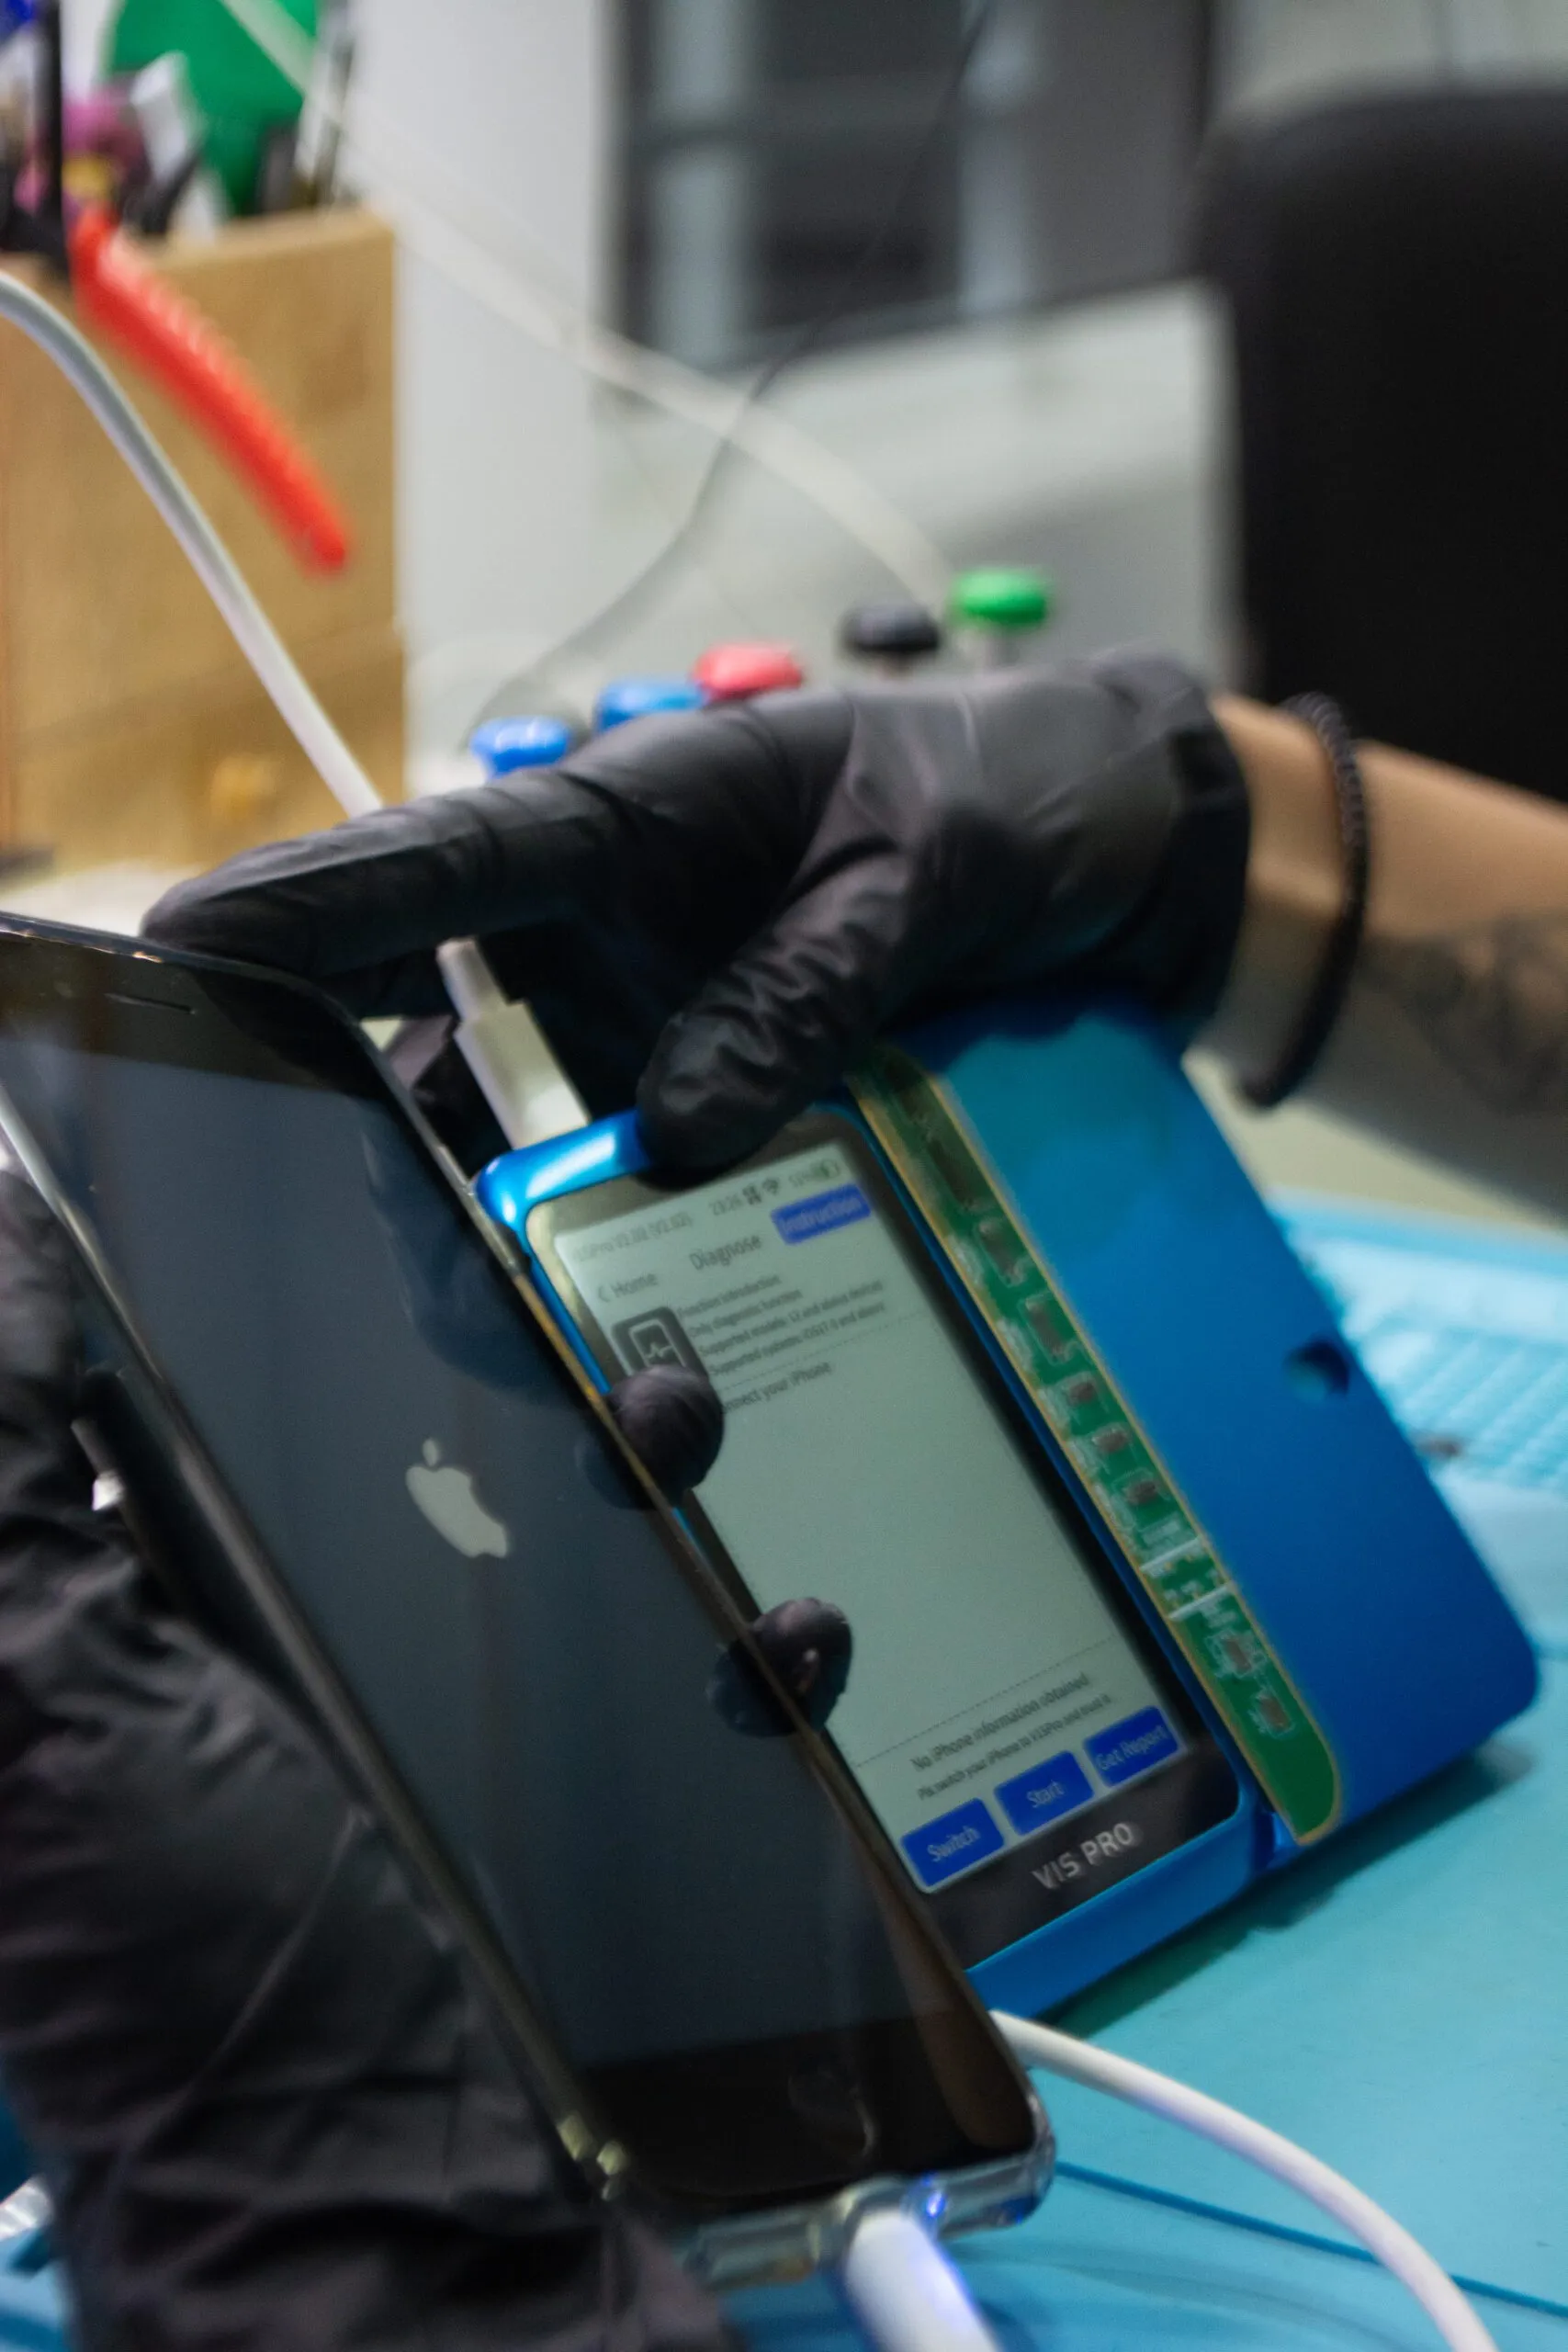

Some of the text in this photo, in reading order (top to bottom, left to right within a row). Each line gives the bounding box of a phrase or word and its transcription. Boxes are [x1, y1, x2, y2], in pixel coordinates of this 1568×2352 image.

[690, 1235, 761, 1272] Diagnose
[610, 1272, 660, 1298] Home
[761, 1379, 788, 1402] your
[789, 1362, 832, 1385] iPhone
[909, 1671, 1090, 1773] No iPhone information obtained
[964, 1758, 987, 1780] your
[987, 1742, 1021, 1765] iPhone
[1096, 1724, 1170, 1771] Get Report
[1026, 1779, 1065, 1808] Start
[926, 1825, 981, 1862] Switch
[1079, 1822, 1137, 1867] PRO
